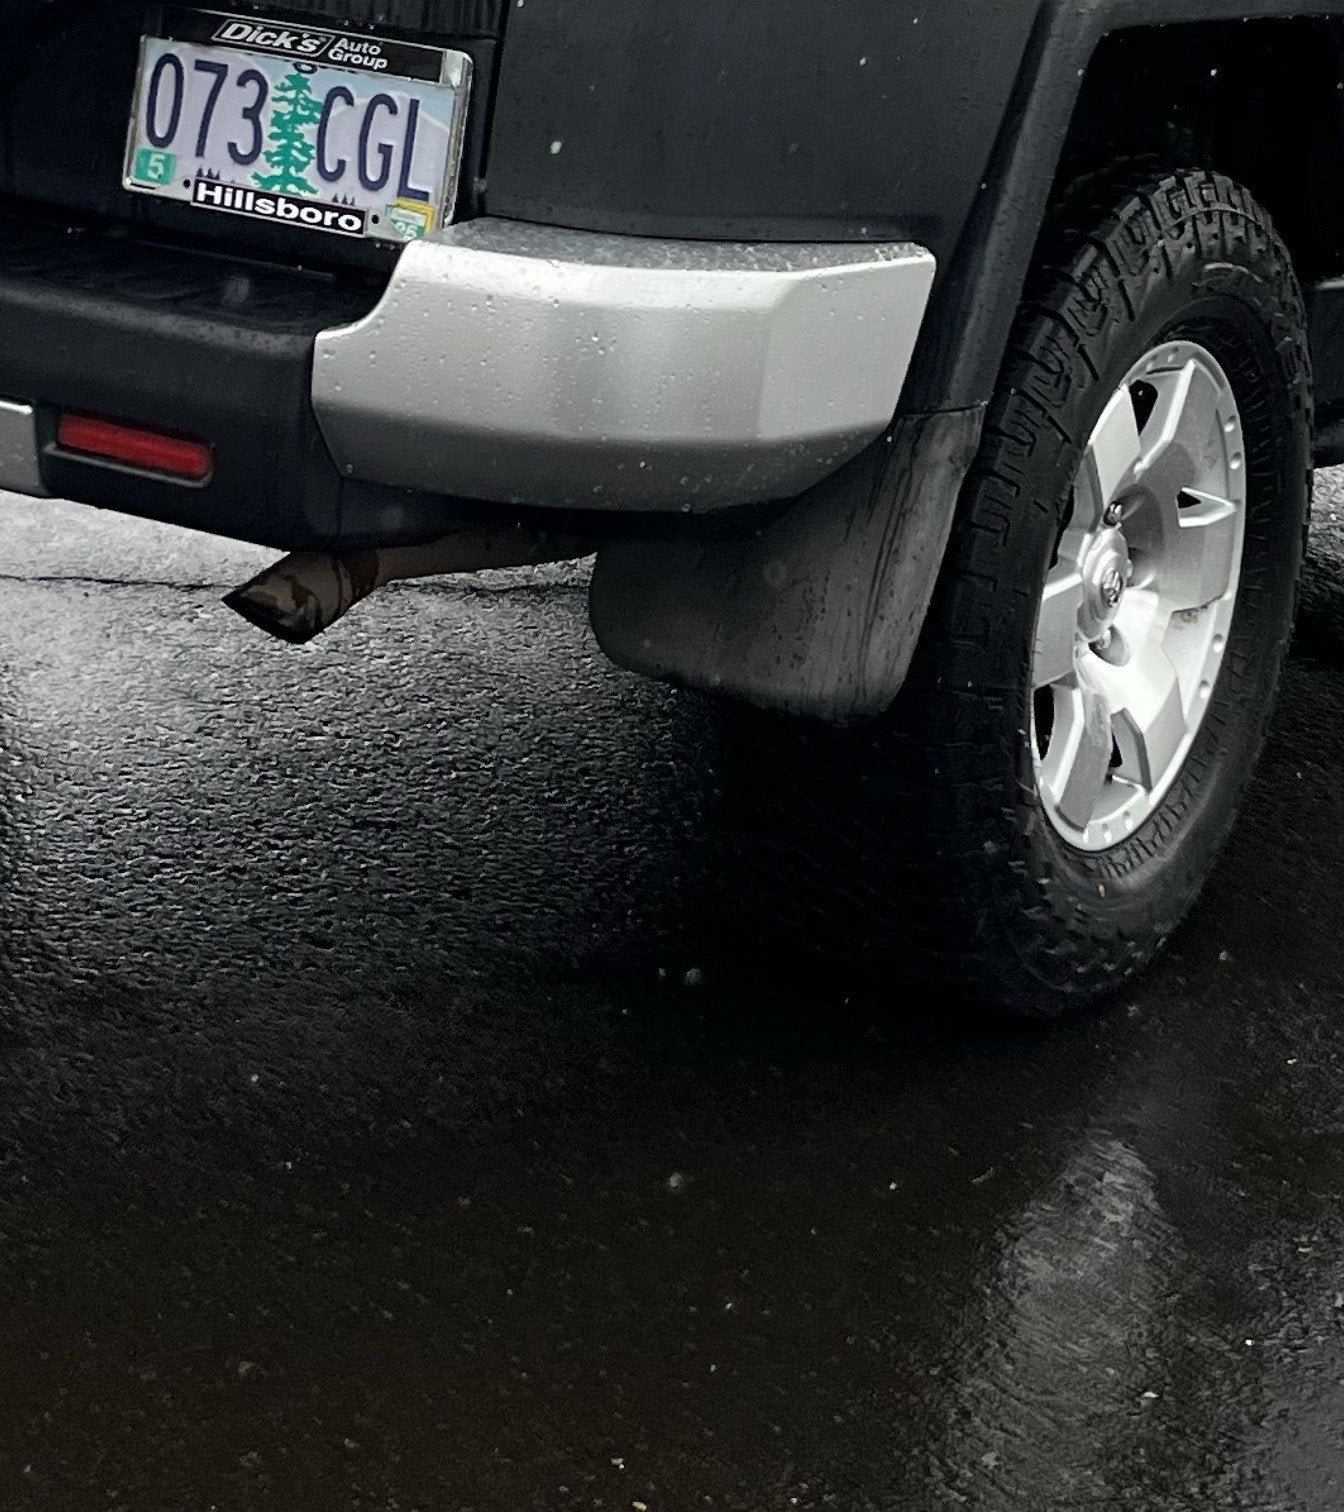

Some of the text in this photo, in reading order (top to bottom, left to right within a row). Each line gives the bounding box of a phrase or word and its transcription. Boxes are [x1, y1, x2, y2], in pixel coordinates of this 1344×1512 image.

[220, 22, 322, 54] Dick's
[333, 37, 382, 56] Auto
[327, 47, 389, 71] Group
[145, 51, 430, 201] 073 CGL
[145, 153, 165, 179] 5
[196, 181, 362, 234] Hillsboro
